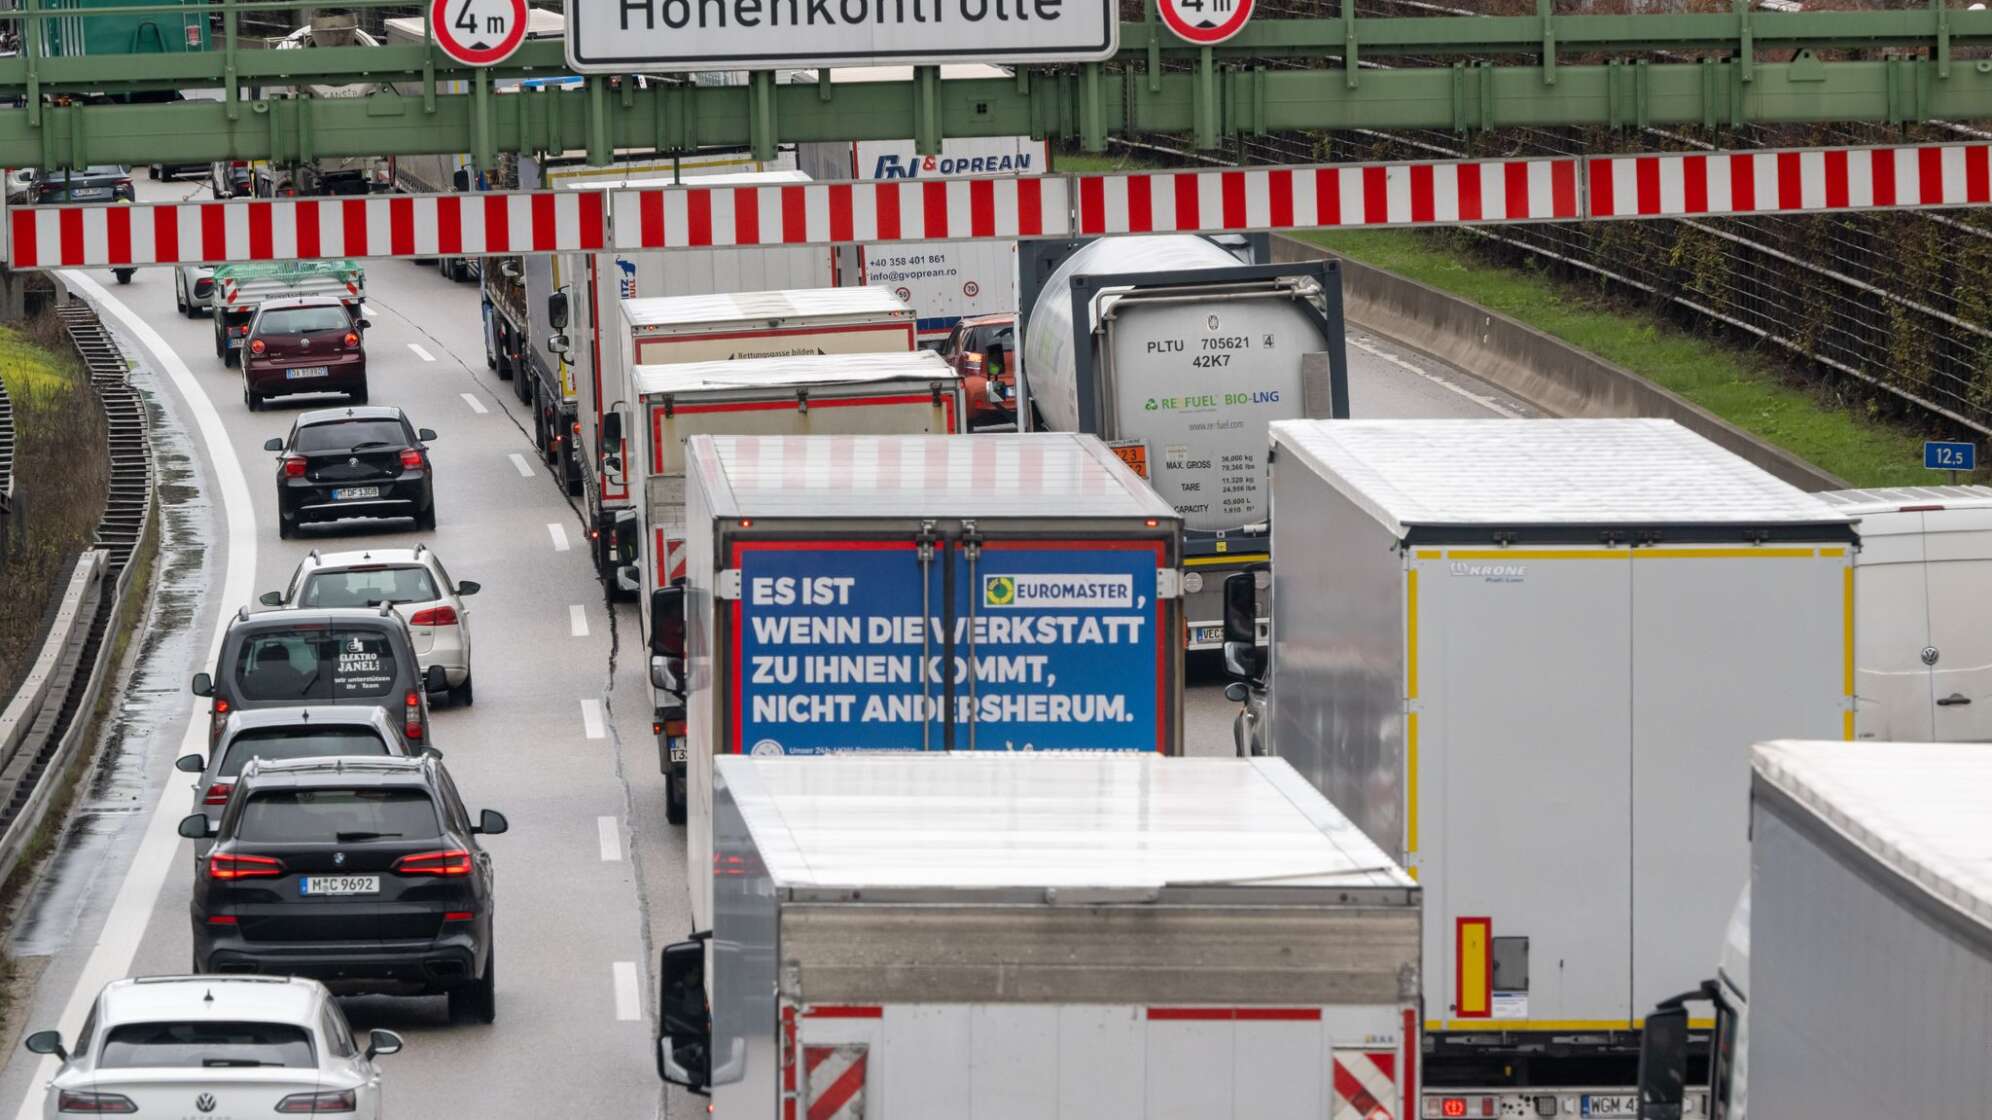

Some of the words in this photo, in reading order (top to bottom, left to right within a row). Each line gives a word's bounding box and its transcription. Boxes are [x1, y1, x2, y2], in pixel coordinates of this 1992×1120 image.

[455, 0, 478, 34] 4
[487, 16, 504, 34] m
[940, 153, 1031, 174] OPREAN
[870, 258, 887, 267] +40
[889, 257, 906, 266] 358
[908, 256, 925, 265] 401
[928, 255, 945, 264] 861
[870, 268, 957, 282] info@gvoprean.ro
[1147, 340, 1184, 353] PLTU
[1201, 337, 1249, 351] 705621
[1192, 355, 1231, 368] 42K7
[1225, 391, 1280, 405] BIO-LNG
[1186, 460, 1211, 470] GROSS
[1181, 483, 1200, 491] TARE
[1174, 504, 1209, 514] CAPACITY
[1469, 566, 1528, 576] KRONE
[752, 577, 796, 605] ES
[802, 577, 855, 605] IST
[1017, 583, 1128, 599] EUROMASTER
[751, 616, 861, 645] WENN
[868, 616, 925, 645] DIE
[930, 616, 1145, 644] WERKSTATT
[339, 653, 377, 661] ELEKTRO
[752, 656, 798, 685] ZU
[804, 656, 911, 684] IHNEN
[919, 656, 1056, 688] KOMMT,
[753, 695, 856, 723] NICHT
[672, 750, 687, 761] T3
[1592, 1097, 1620, 1113] WGM
